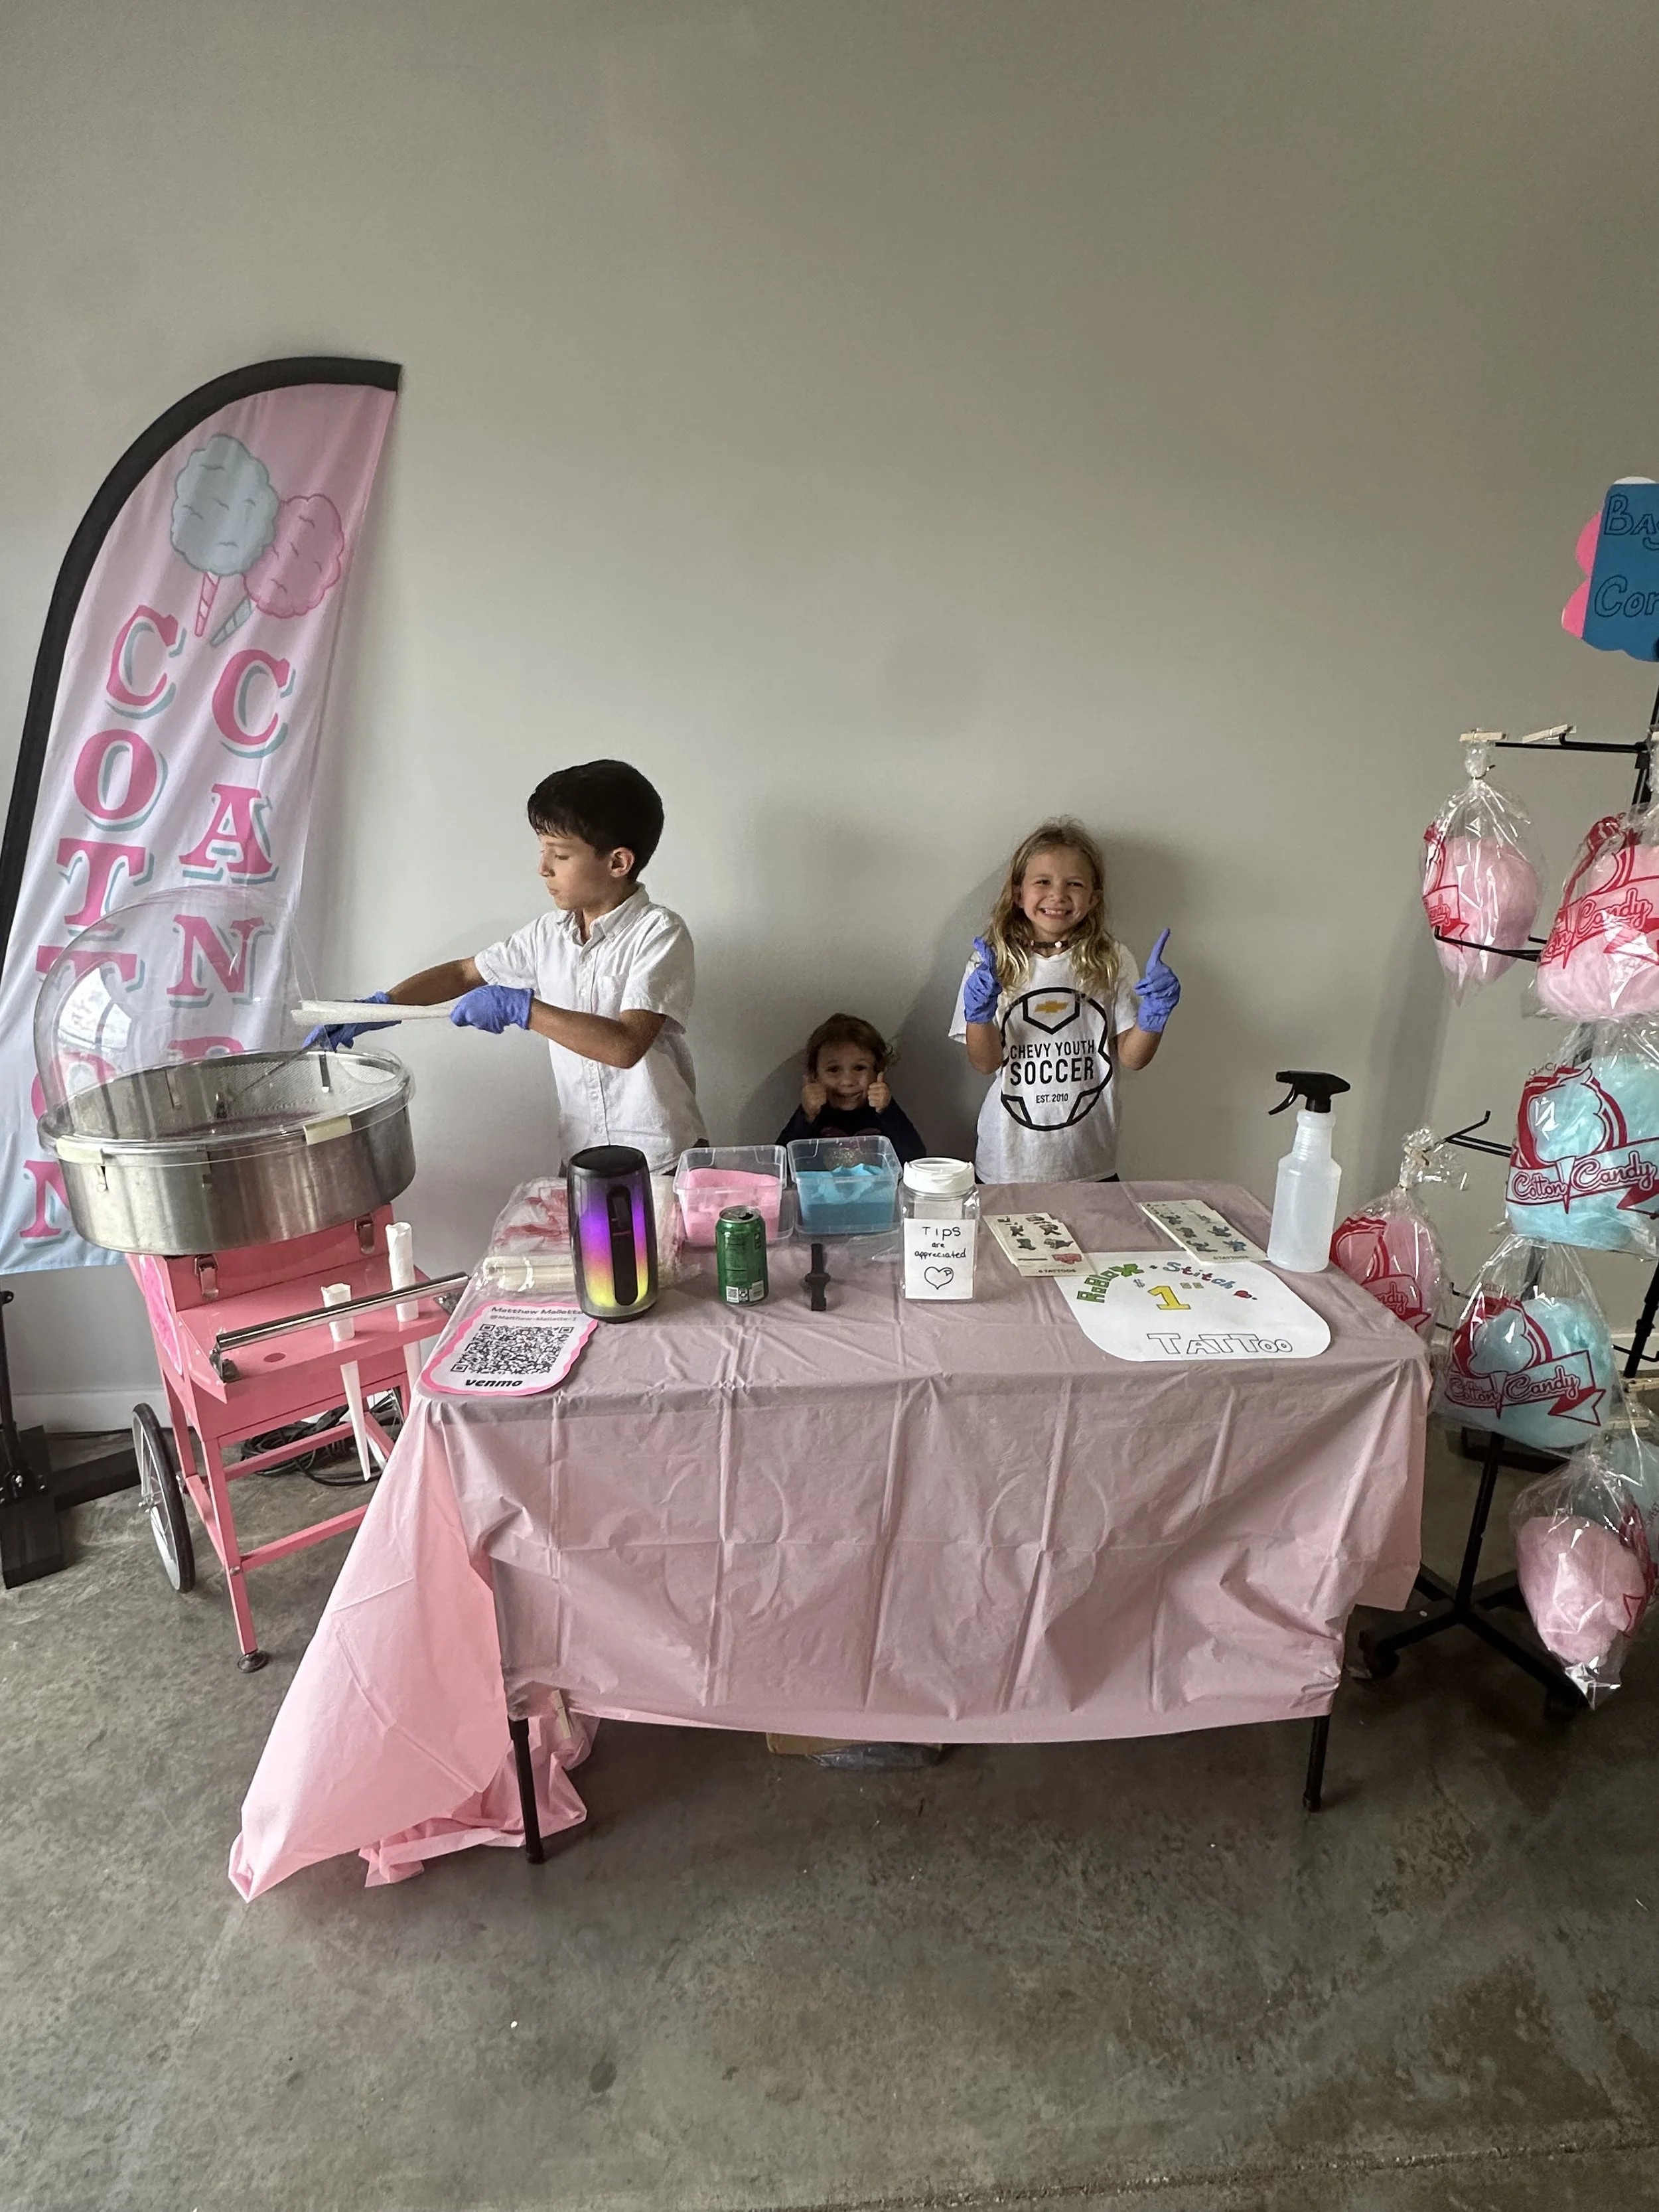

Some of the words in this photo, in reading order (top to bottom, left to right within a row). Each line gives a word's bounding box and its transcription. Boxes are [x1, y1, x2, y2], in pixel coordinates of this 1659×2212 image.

[1010, 1043, 1051, 1059] CHEVY
[1055, 1039, 1094, 1057] YOUTH
[1009, 1057, 1094, 1086] SOCCER
[1036, 1094, 1050, 1104] EST.
[1052, 1093, 1068, 1102] 2010
[1512, 1171, 1568, 1200] Cotton
[1571, 1149, 1658, 1192] Candy
[914, 1248, 966, 1260] appreciated
[1163, 1261, 1236, 1289] Stitch
[1373, 1280, 1409, 1316] ndy
[465, 1379, 524, 1388] venmo
[1504, 1364, 1581, 1402] Candy
